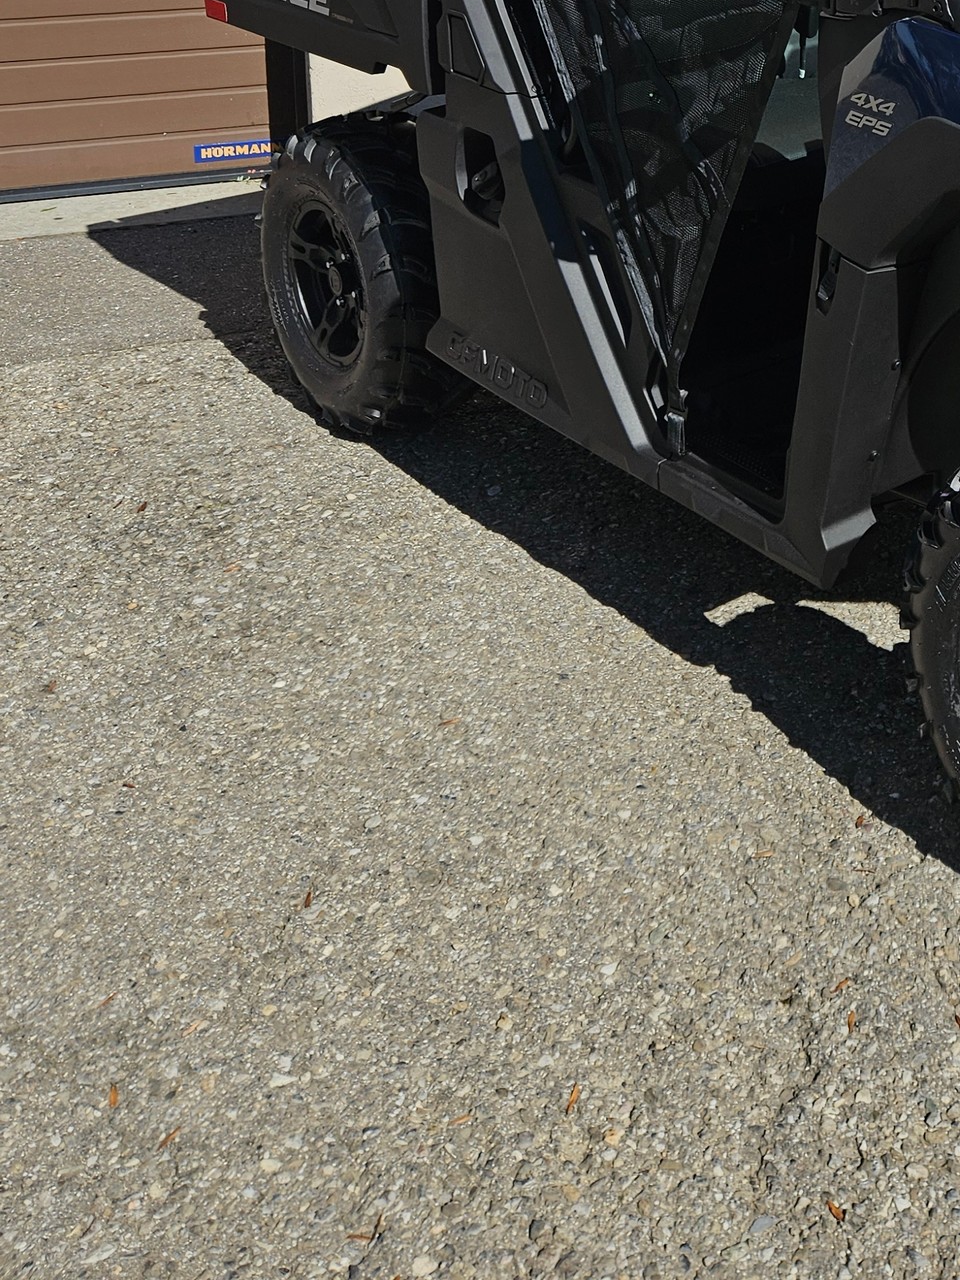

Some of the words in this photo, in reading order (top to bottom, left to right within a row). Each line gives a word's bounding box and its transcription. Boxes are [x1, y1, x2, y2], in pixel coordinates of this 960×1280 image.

[850, 92, 896, 116] 4X4
[845, 110, 893, 137] EPS
[447, 329, 549, 409] CFMOTO
